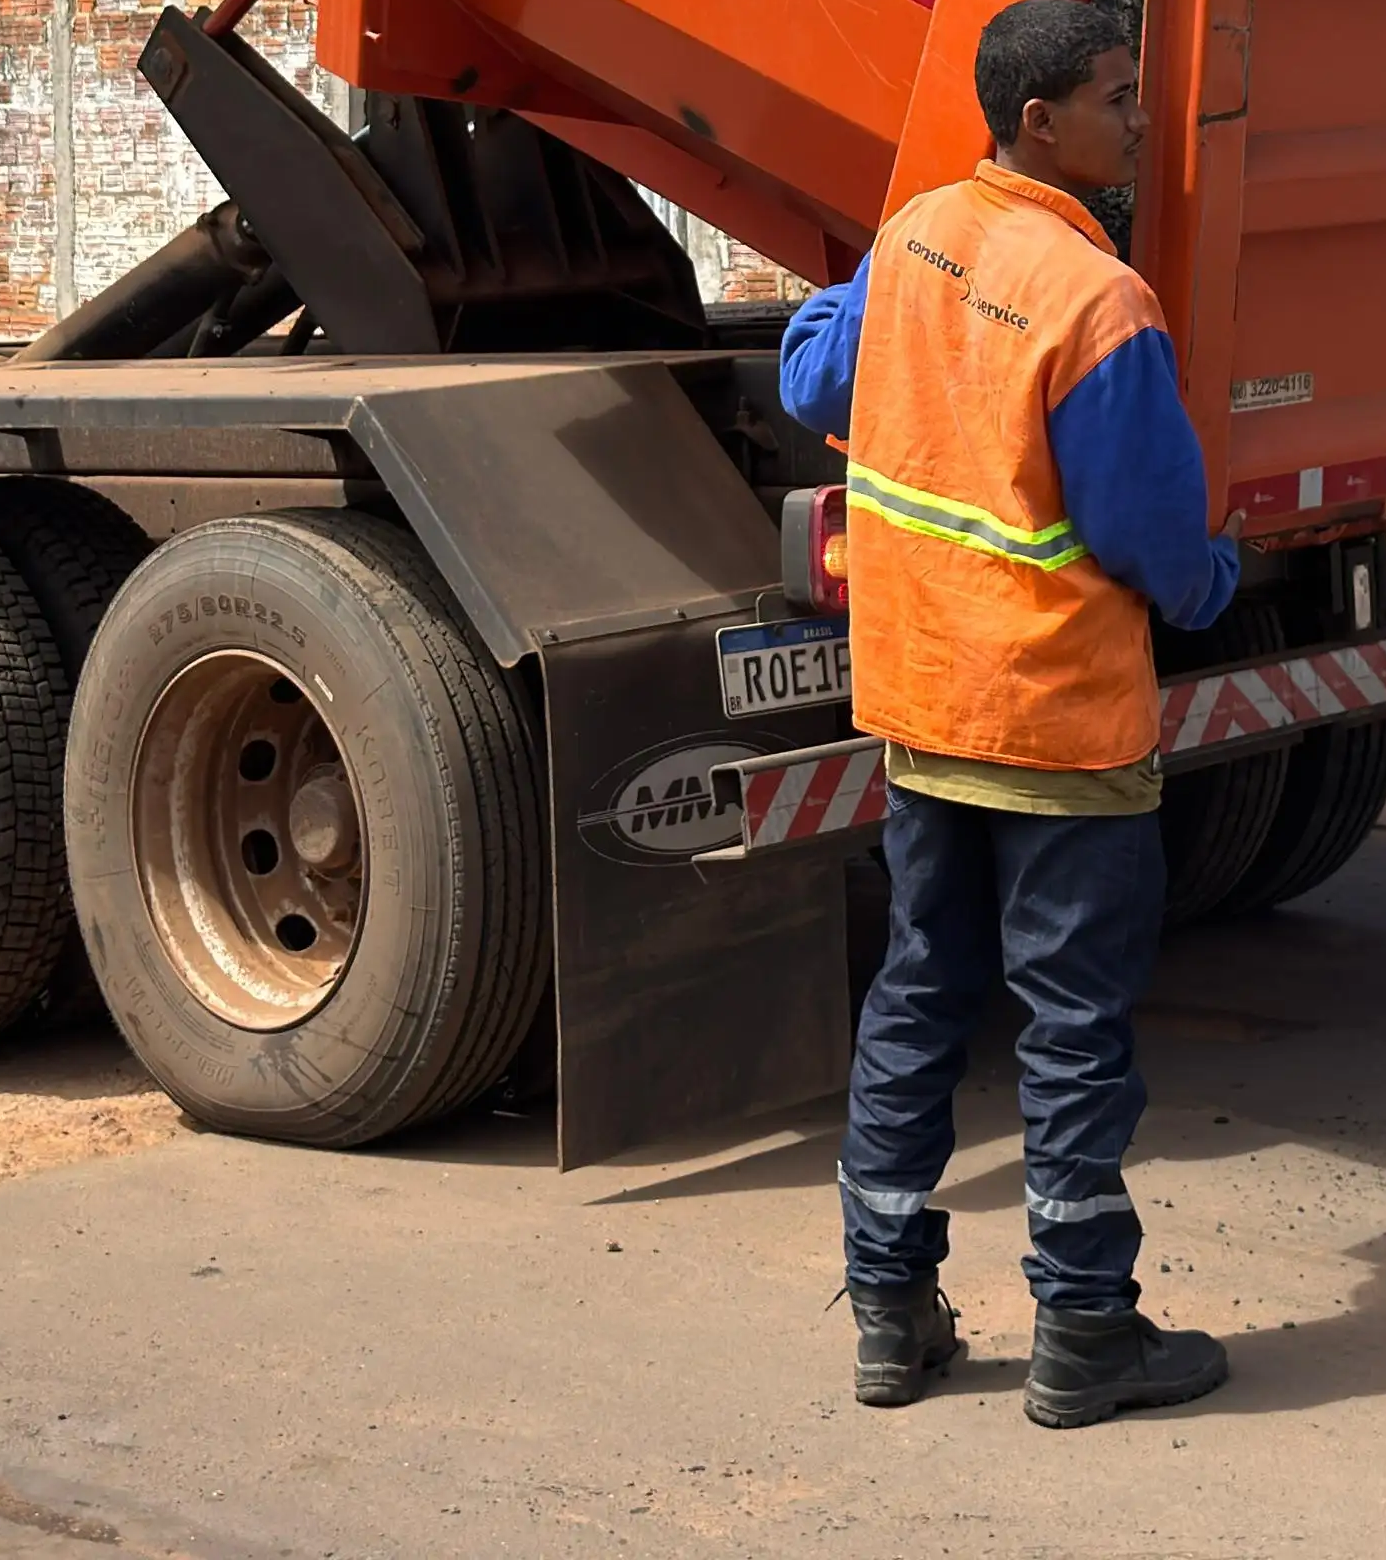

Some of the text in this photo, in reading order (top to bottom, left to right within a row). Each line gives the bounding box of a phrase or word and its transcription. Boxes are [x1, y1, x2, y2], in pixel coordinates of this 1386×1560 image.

[1250, 374, 1312, 398] 3220-4116
[148, 594, 307, 649] 275/80R22.5
[803, 626, 834, 640] BRASIL
[729, 695, 743, 712] BR
[631, 776, 732, 834] MM
